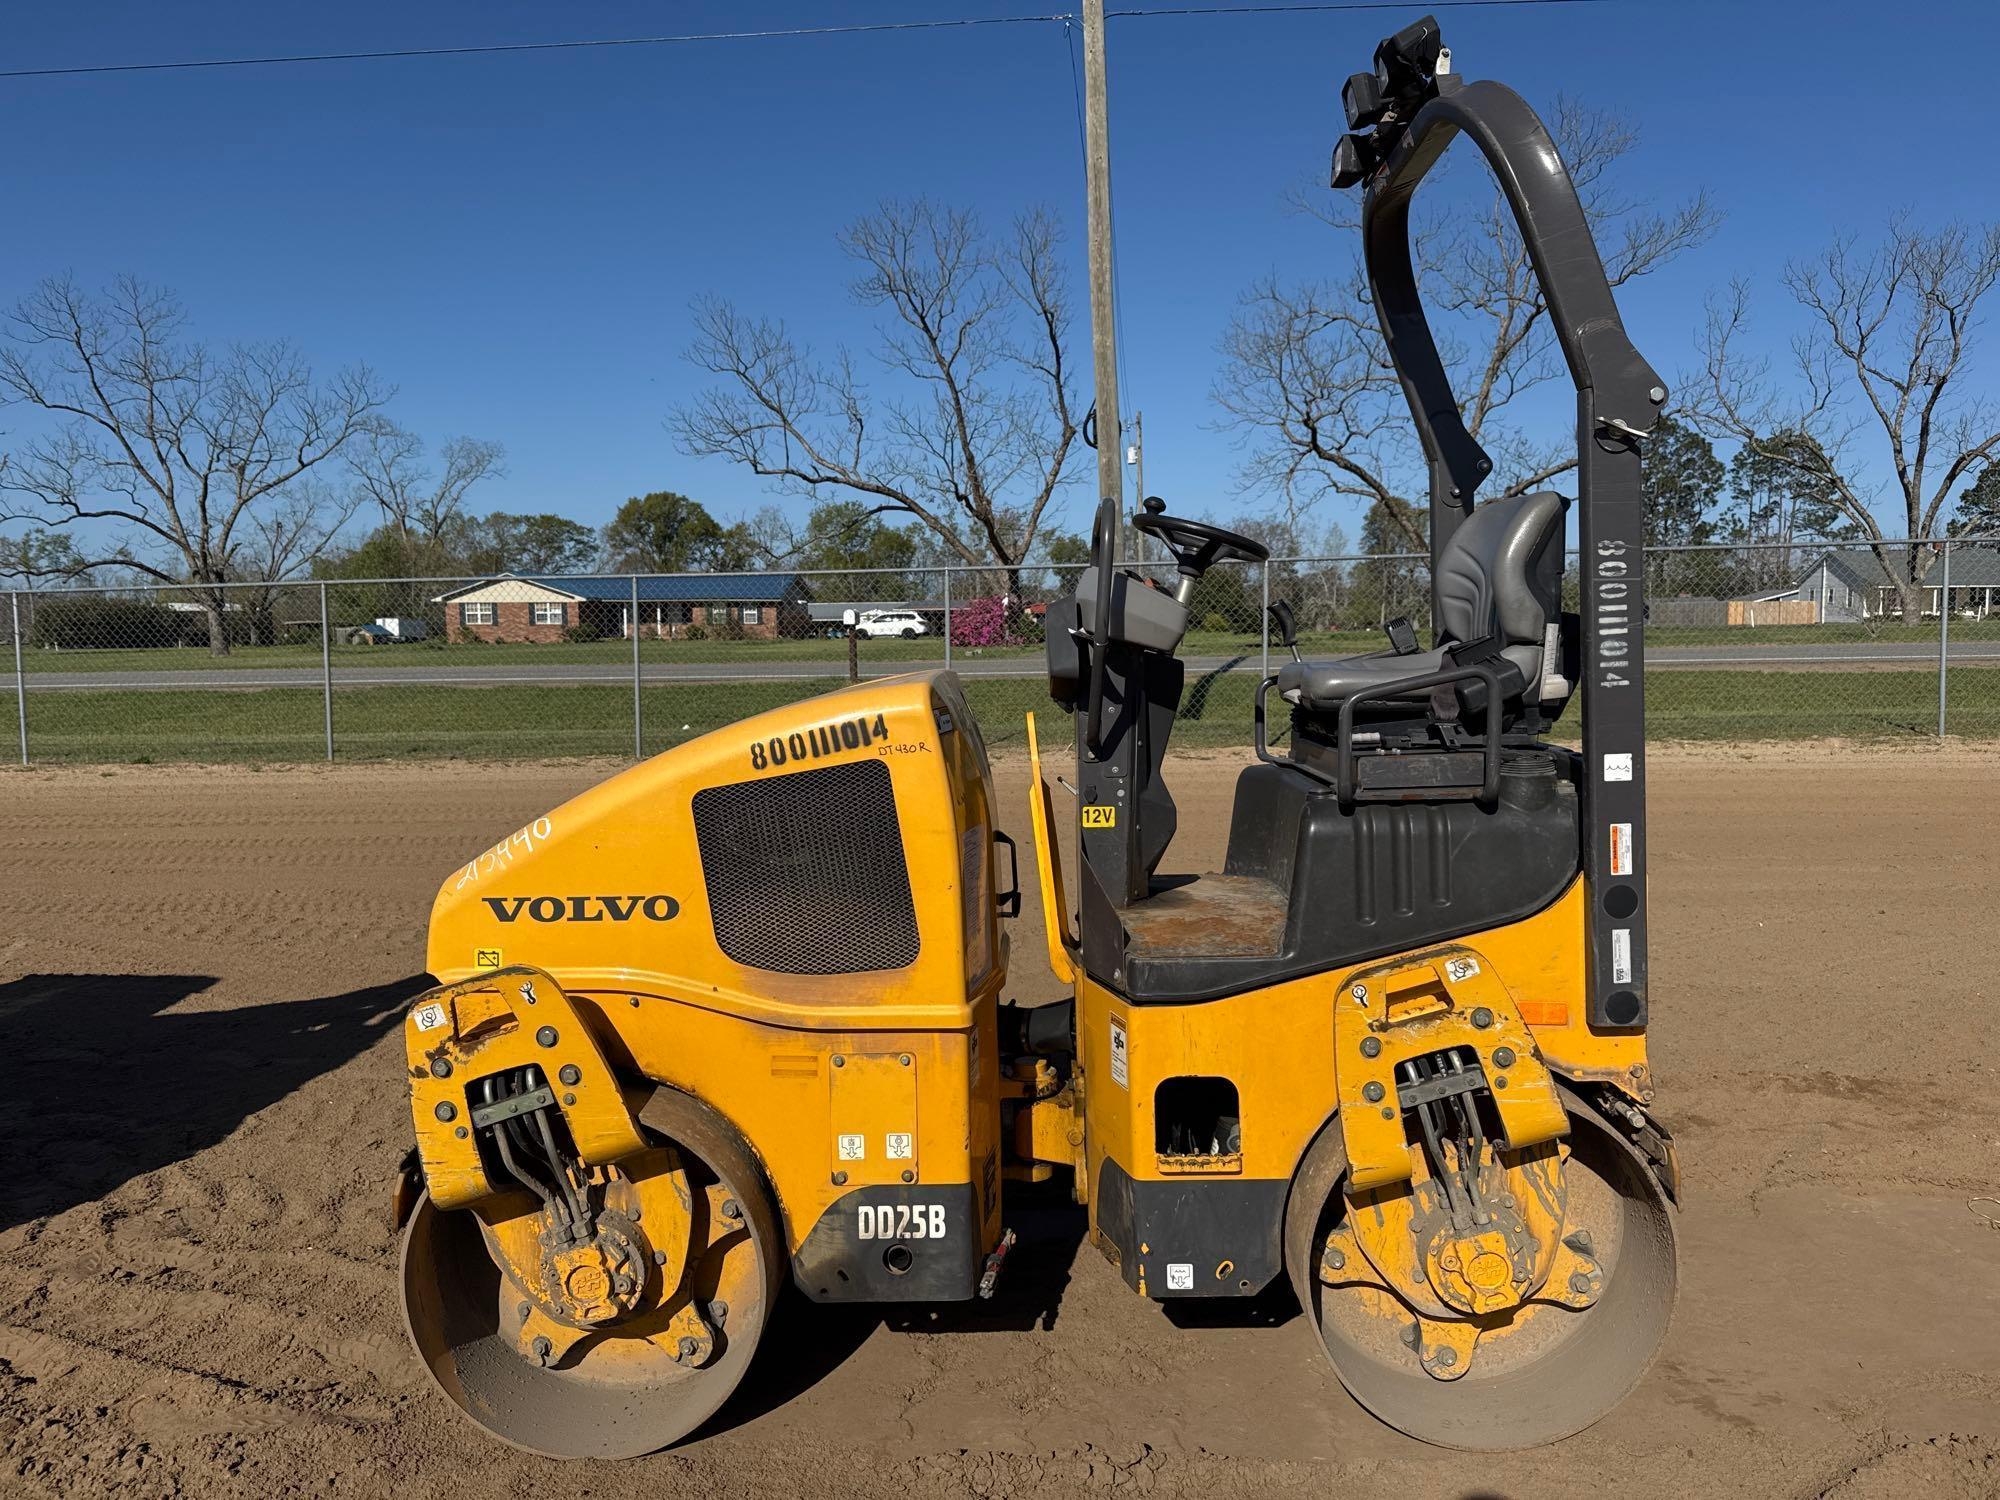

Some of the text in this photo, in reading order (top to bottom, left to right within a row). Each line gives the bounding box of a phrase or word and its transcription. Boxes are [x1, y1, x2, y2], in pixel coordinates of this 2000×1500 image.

[1597, 539, 1630, 688] 800111014
[750, 713, 889, 770] 800111014
[1084, 808, 1113, 823] 12V
[481, 895, 680, 922] VOLVO
[858, 1204, 947, 1240] DD25B
